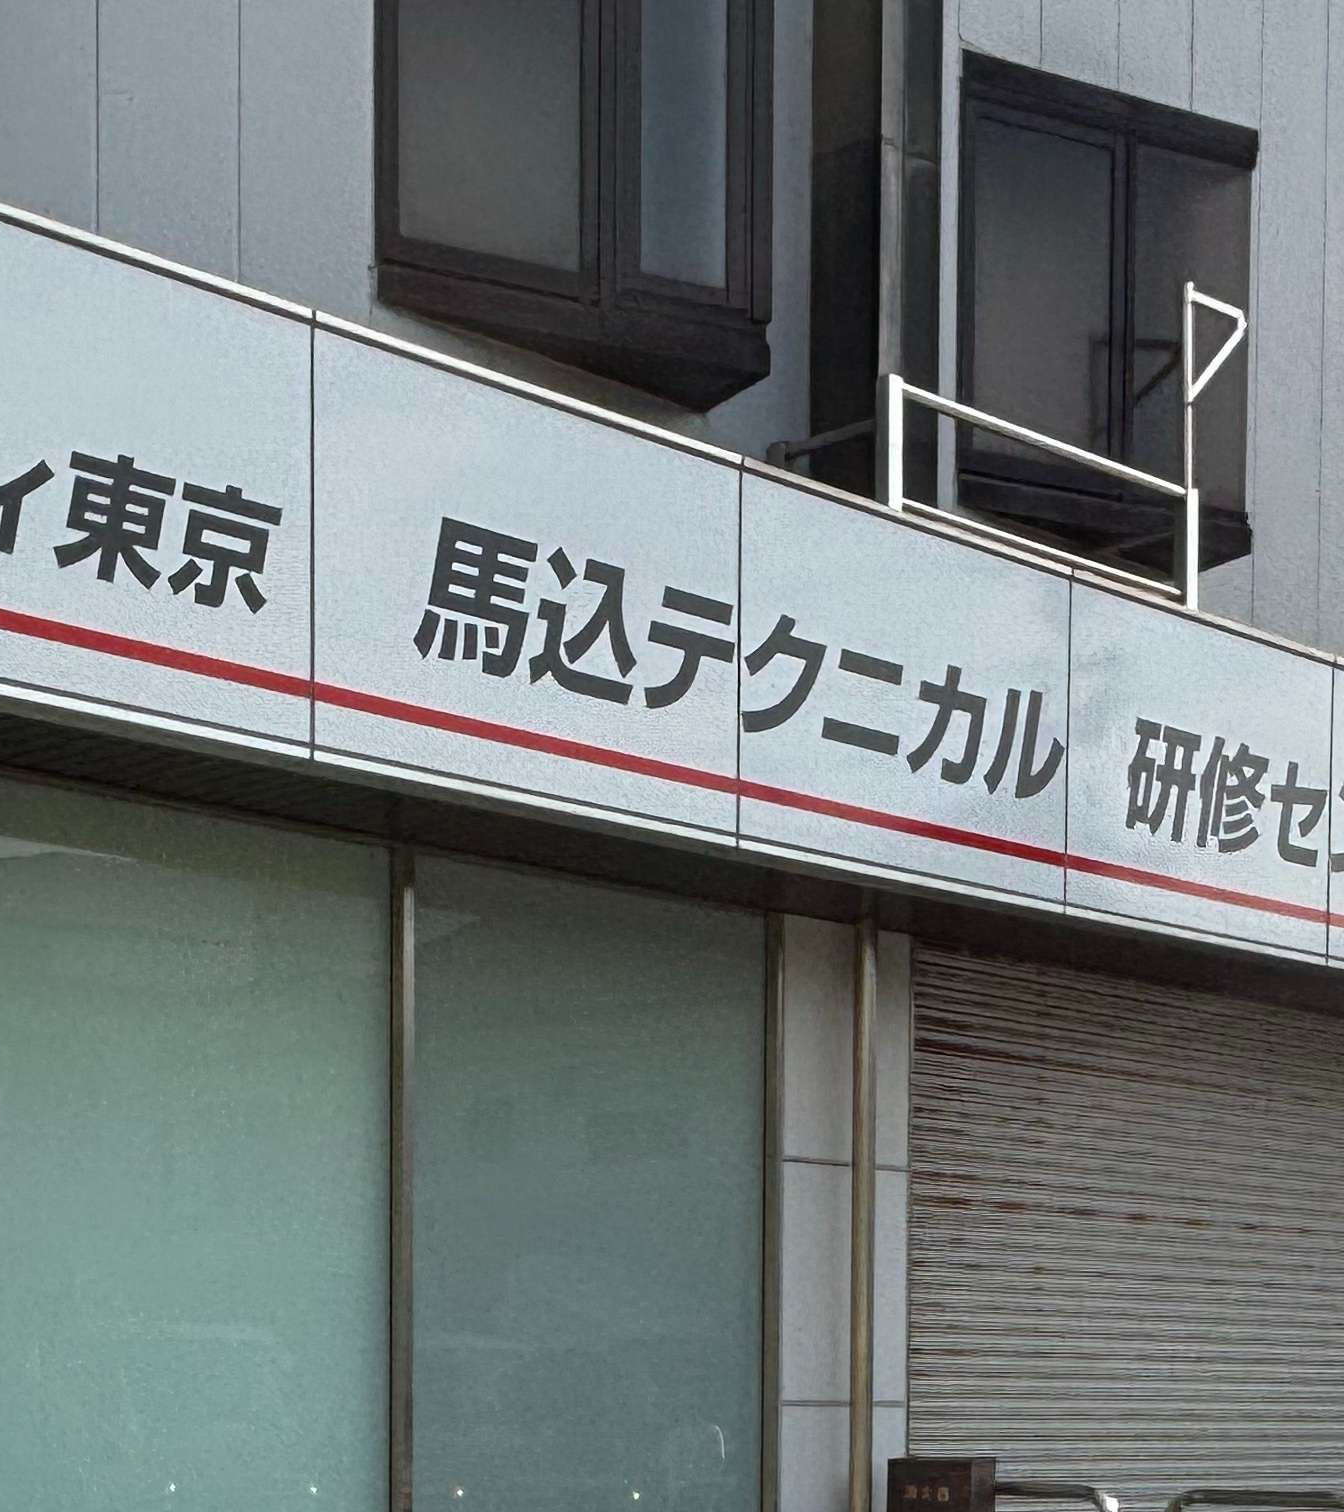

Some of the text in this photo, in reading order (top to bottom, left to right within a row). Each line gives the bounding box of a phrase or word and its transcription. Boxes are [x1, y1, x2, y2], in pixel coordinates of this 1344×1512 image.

[413, 516, 1065, 799] 馬込テクニカル
